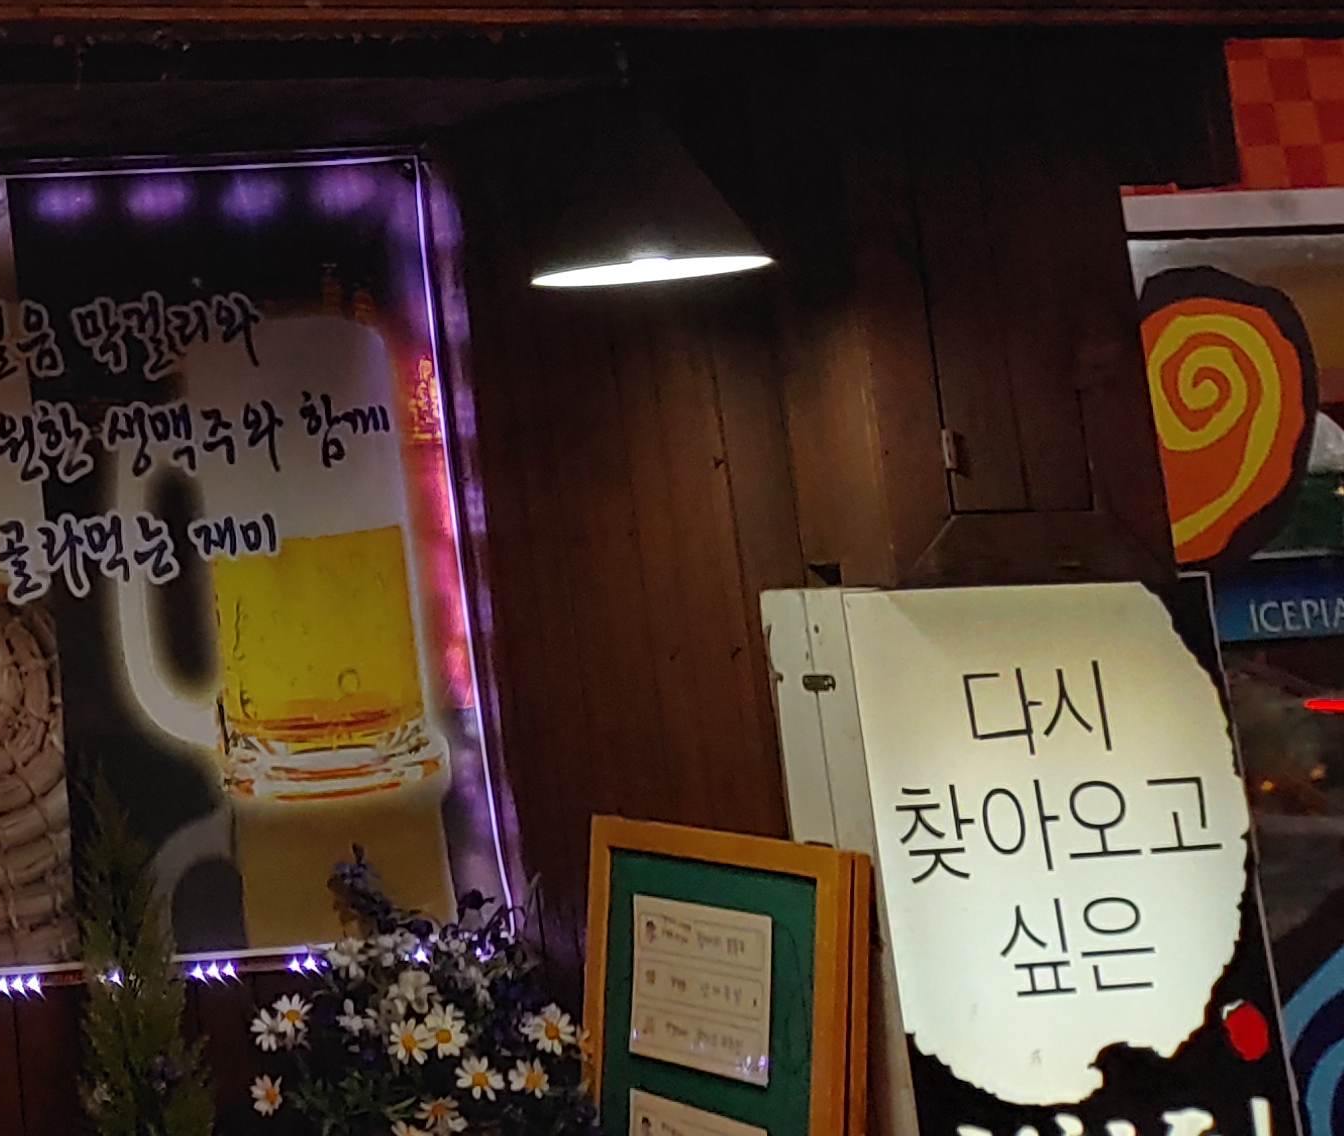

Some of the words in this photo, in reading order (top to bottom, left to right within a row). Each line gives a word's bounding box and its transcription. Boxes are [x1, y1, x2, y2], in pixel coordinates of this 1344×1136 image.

[74, 295, 262, 379] 막걸리와
[109, 400, 284, 476] 생맥주와
[299, 390, 391, 468] 함께
[195, 514, 278, 556] 재미
[962, 659, 1114, 755] 다시
[895, 776, 1223, 884] 찾아오고
[1000, 889, 1156, 997] 싶은
